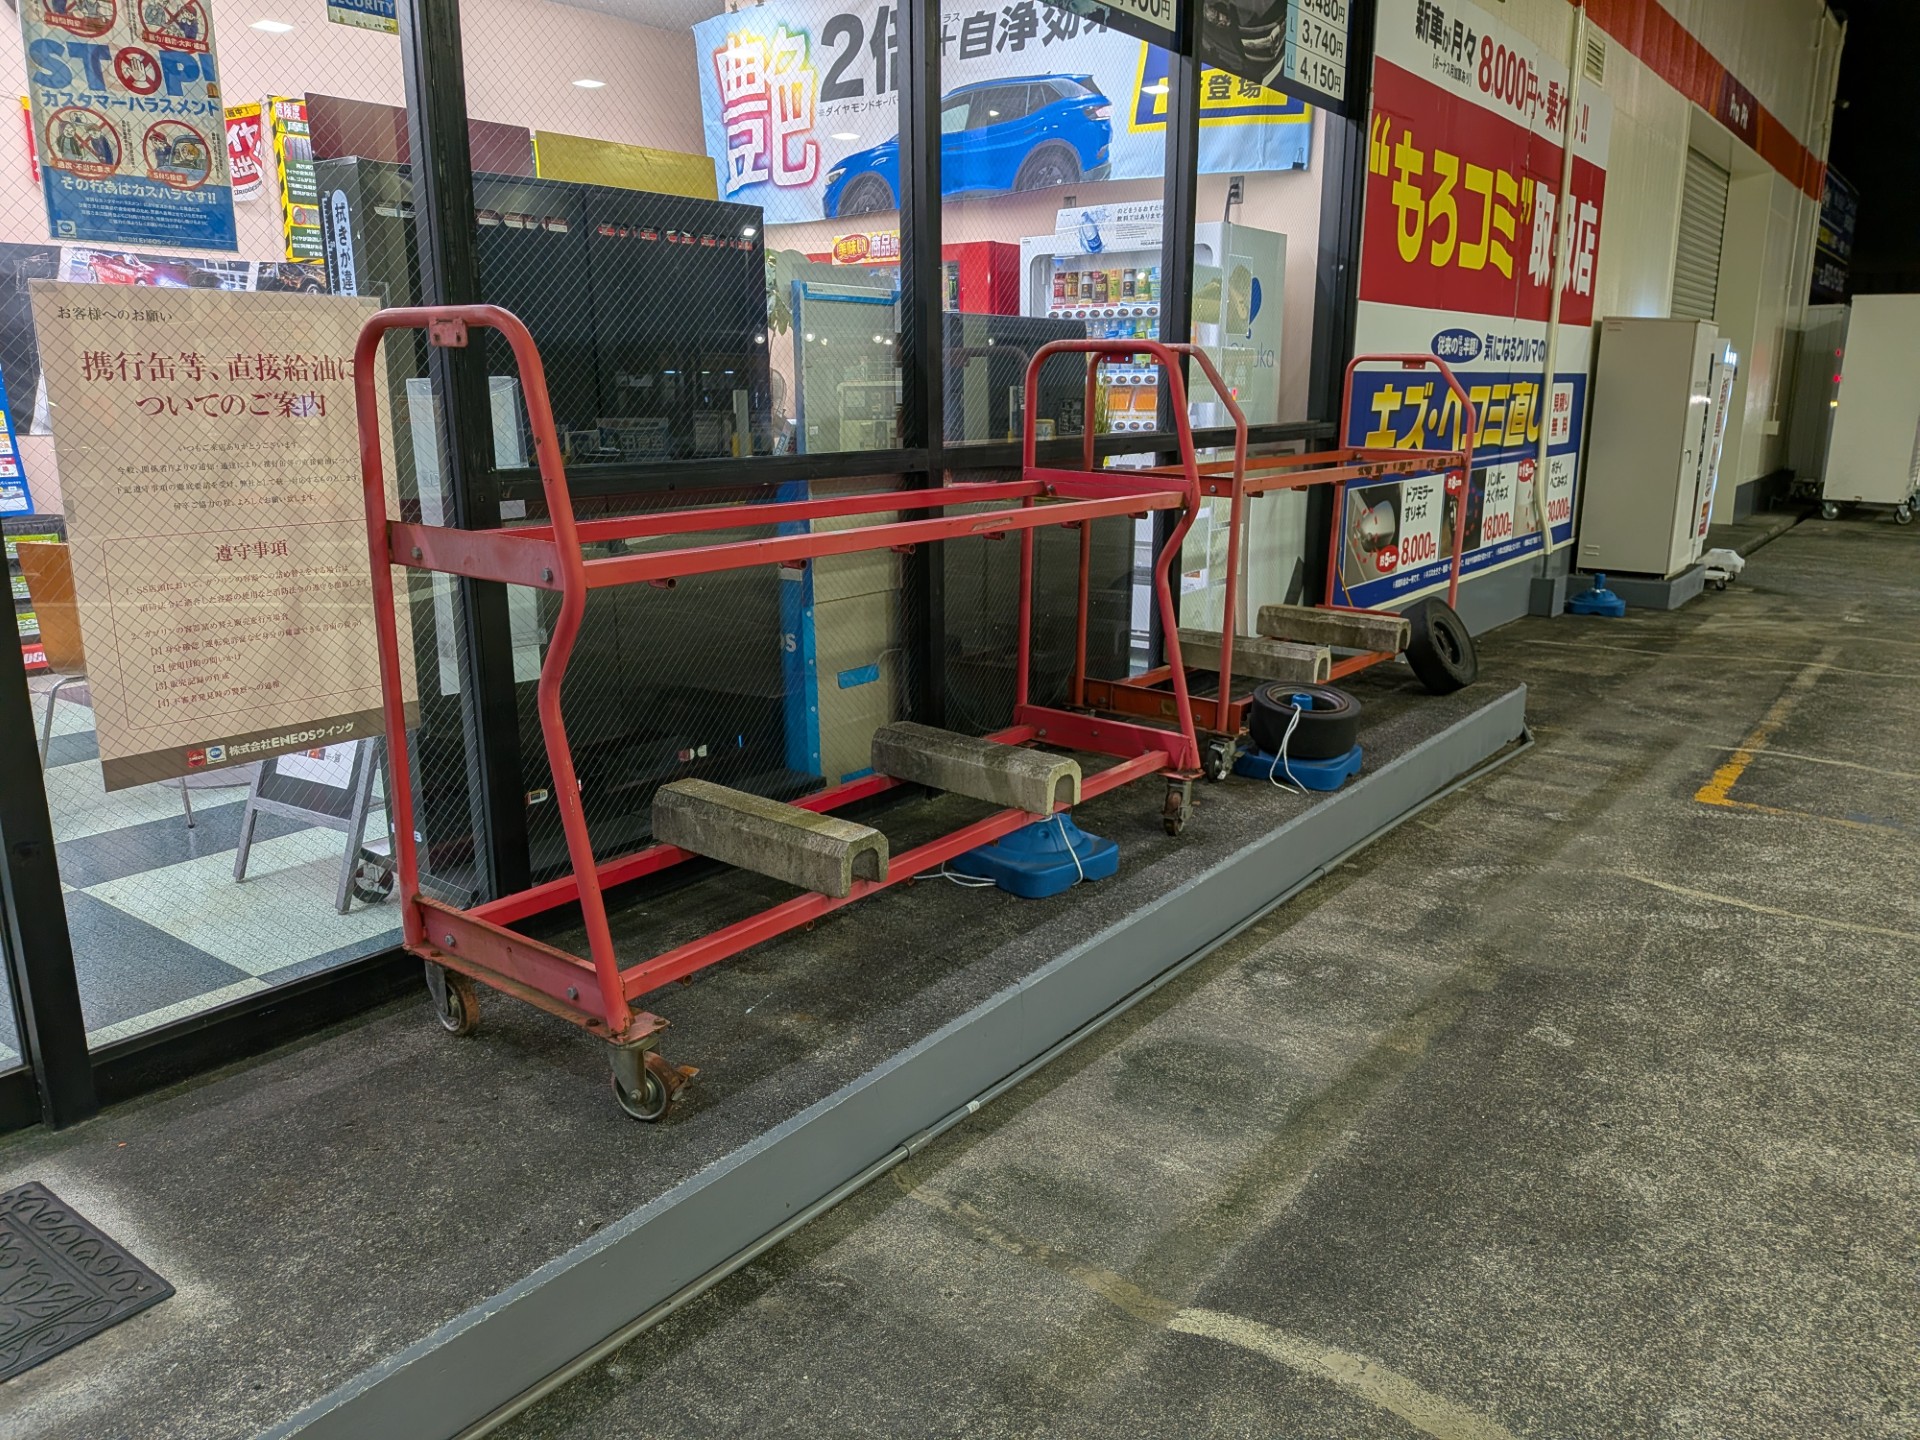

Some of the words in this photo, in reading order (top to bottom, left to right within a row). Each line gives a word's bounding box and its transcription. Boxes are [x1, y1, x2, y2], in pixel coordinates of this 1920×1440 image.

[1302, 20, 1343, 58] 3,740円
[1200, 75, 1262, 100] 登場
[1300, 56, 1341, 93] 4,150円
[41, 90, 220, 117] カスタマーハラスメント
[61, 176, 217, 205] その行為はカスハラです!!
[57, 305, 172, 323] お客様へのお願い
[81, 350, 355, 382] 携行缶等、直接給油に
[136, 390, 326, 418] ついてのご案内
[1406, 485, 1433, 503] ドアミラー
[215, 539, 288, 562] 遵守事項
[1401, 532, 1436, 565] 8,000円
[229, 722, 354, 757] 株式会社ENEOSウイング
